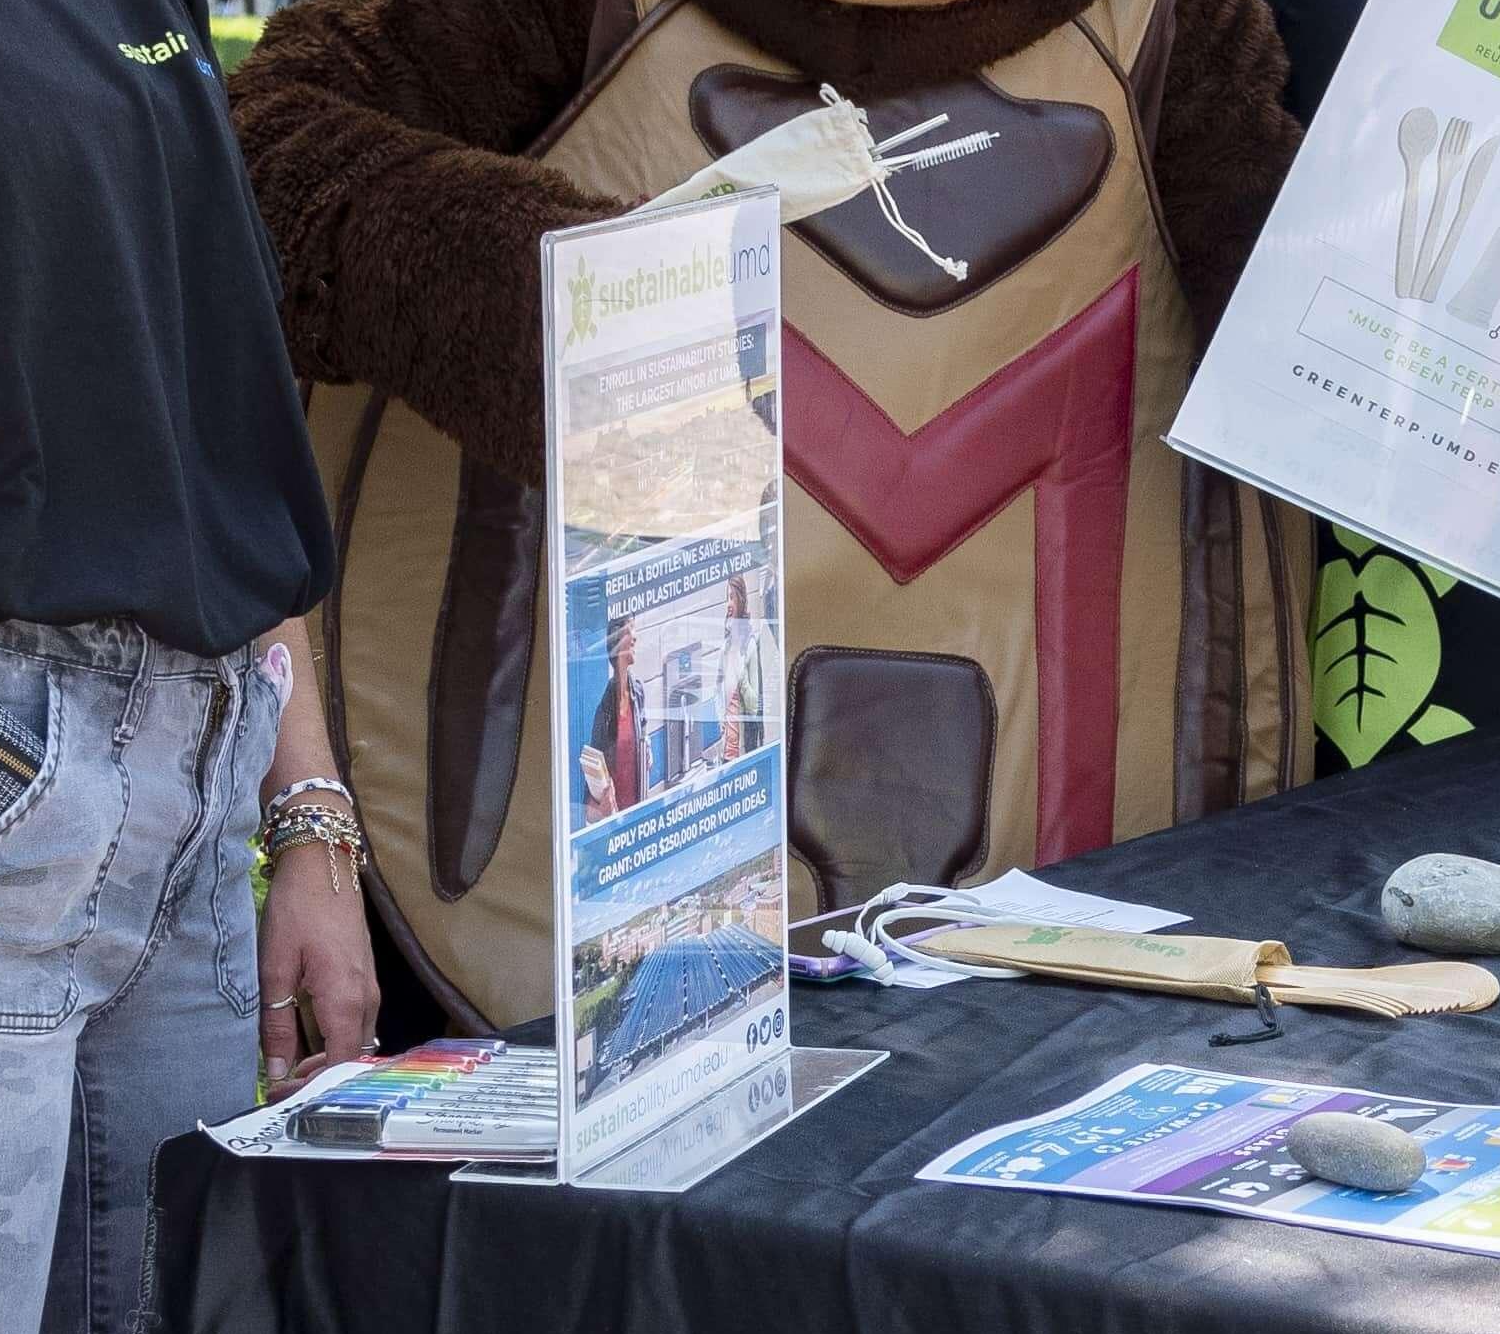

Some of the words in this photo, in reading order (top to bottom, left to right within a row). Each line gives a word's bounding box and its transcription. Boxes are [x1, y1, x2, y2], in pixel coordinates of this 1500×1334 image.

[598, 229, 771, 317] sustainableumd
[599, 369, 636, 394] ENROLL
[637, 366, 648, 382] IN
[647, 344, 717, 379] SUSTAINABILITY
[717, 334, 755, 359] STUDIES:
[1383, 348, 1444, 386] GREEN
[1451, 381, 1495, 410] TERP
[1408, 340, 1432, 358] BE
[1436, 355, 1449, 368] A
[616, 396, 635, 413] THE
[636, 382, 675, 407] LARGEST
[676, 373, 706, 394] MINOR
[706, 369, 719, 387] AT
[720, 363, 741, 383] UMD
[605, 576, 637, 597] REFILL
[637, 572, 645, 585] A
[646, 557, 682, 581] BOTTLE:
[682, 549, 698, 566] WE
[699, 540, 721, 561] SAVE
[607, 594, 645, 622] MILLION
[646, 579, 682, 606] PLASTIC
[684, 568, 721, 592] BOTTLES
[721, 563, 729, 575] A
[729, 552, 752, 571] YEAR
[598, 856, 633, 886] GRANT:
[633, 845, 658, 868] OVER
[658, 823, 698, 858] $250,000
[699, 814, 717, 835] FOR
[717, 801, 741, 828] YOUR
[741, 788, 767, 814] IDEAS
[608, 827, 638, 856] APPLY
[638, 818, 657, 841] FOR
[658, 815, 666, 831] A
[666, 782, 734, 828] SUSTAINABILITY
[734, 769, 758, 794] FUND
[576, 1044, 729, 1154] sustainability.umd.edu
